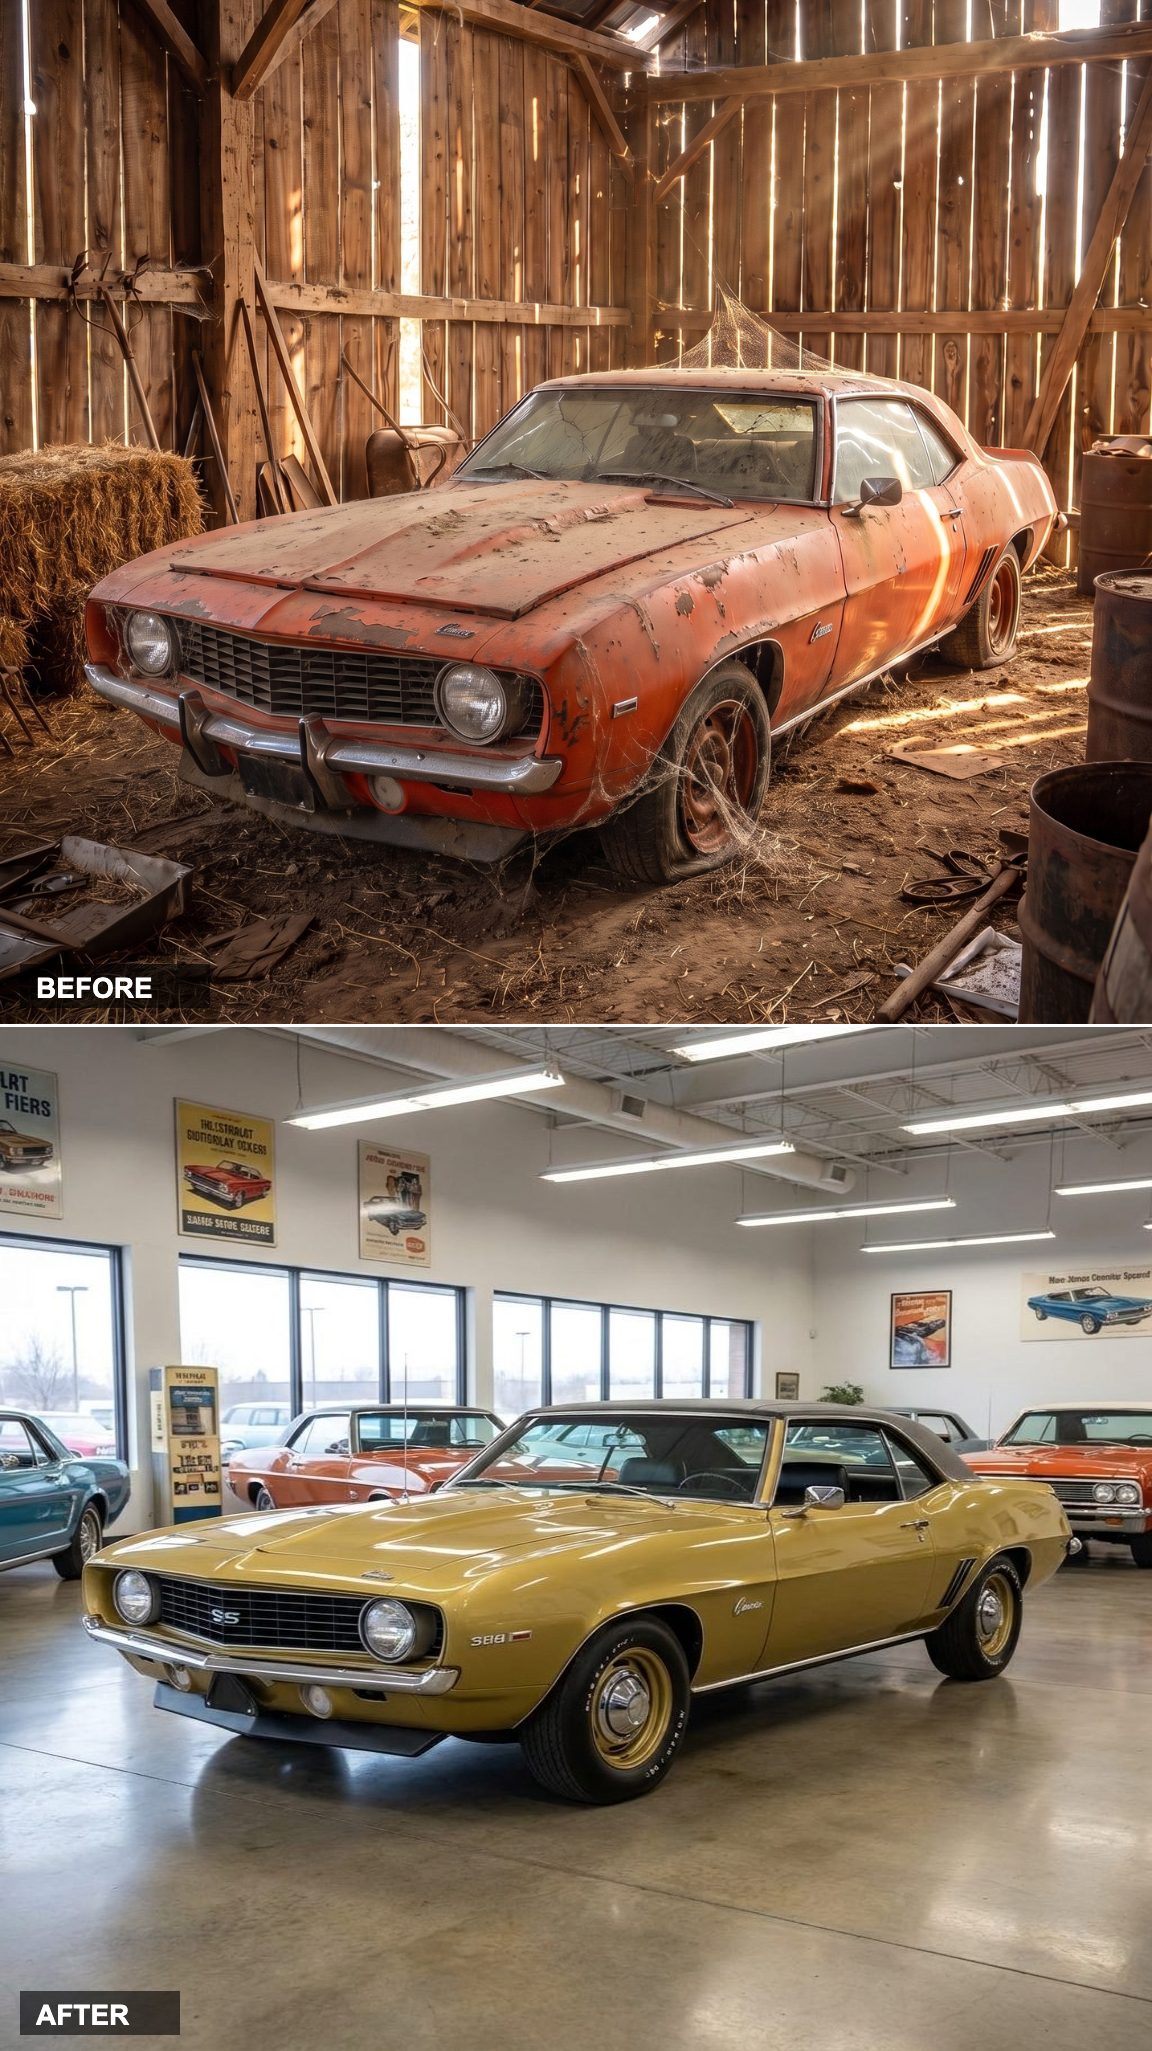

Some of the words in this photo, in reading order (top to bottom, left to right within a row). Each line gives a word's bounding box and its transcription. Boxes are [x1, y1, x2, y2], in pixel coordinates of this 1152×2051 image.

[0, 1071, 29, 1093] LRT
[5, 1092, 51, 1118] FIERS
[211, 1609, 240, 1624] SS
